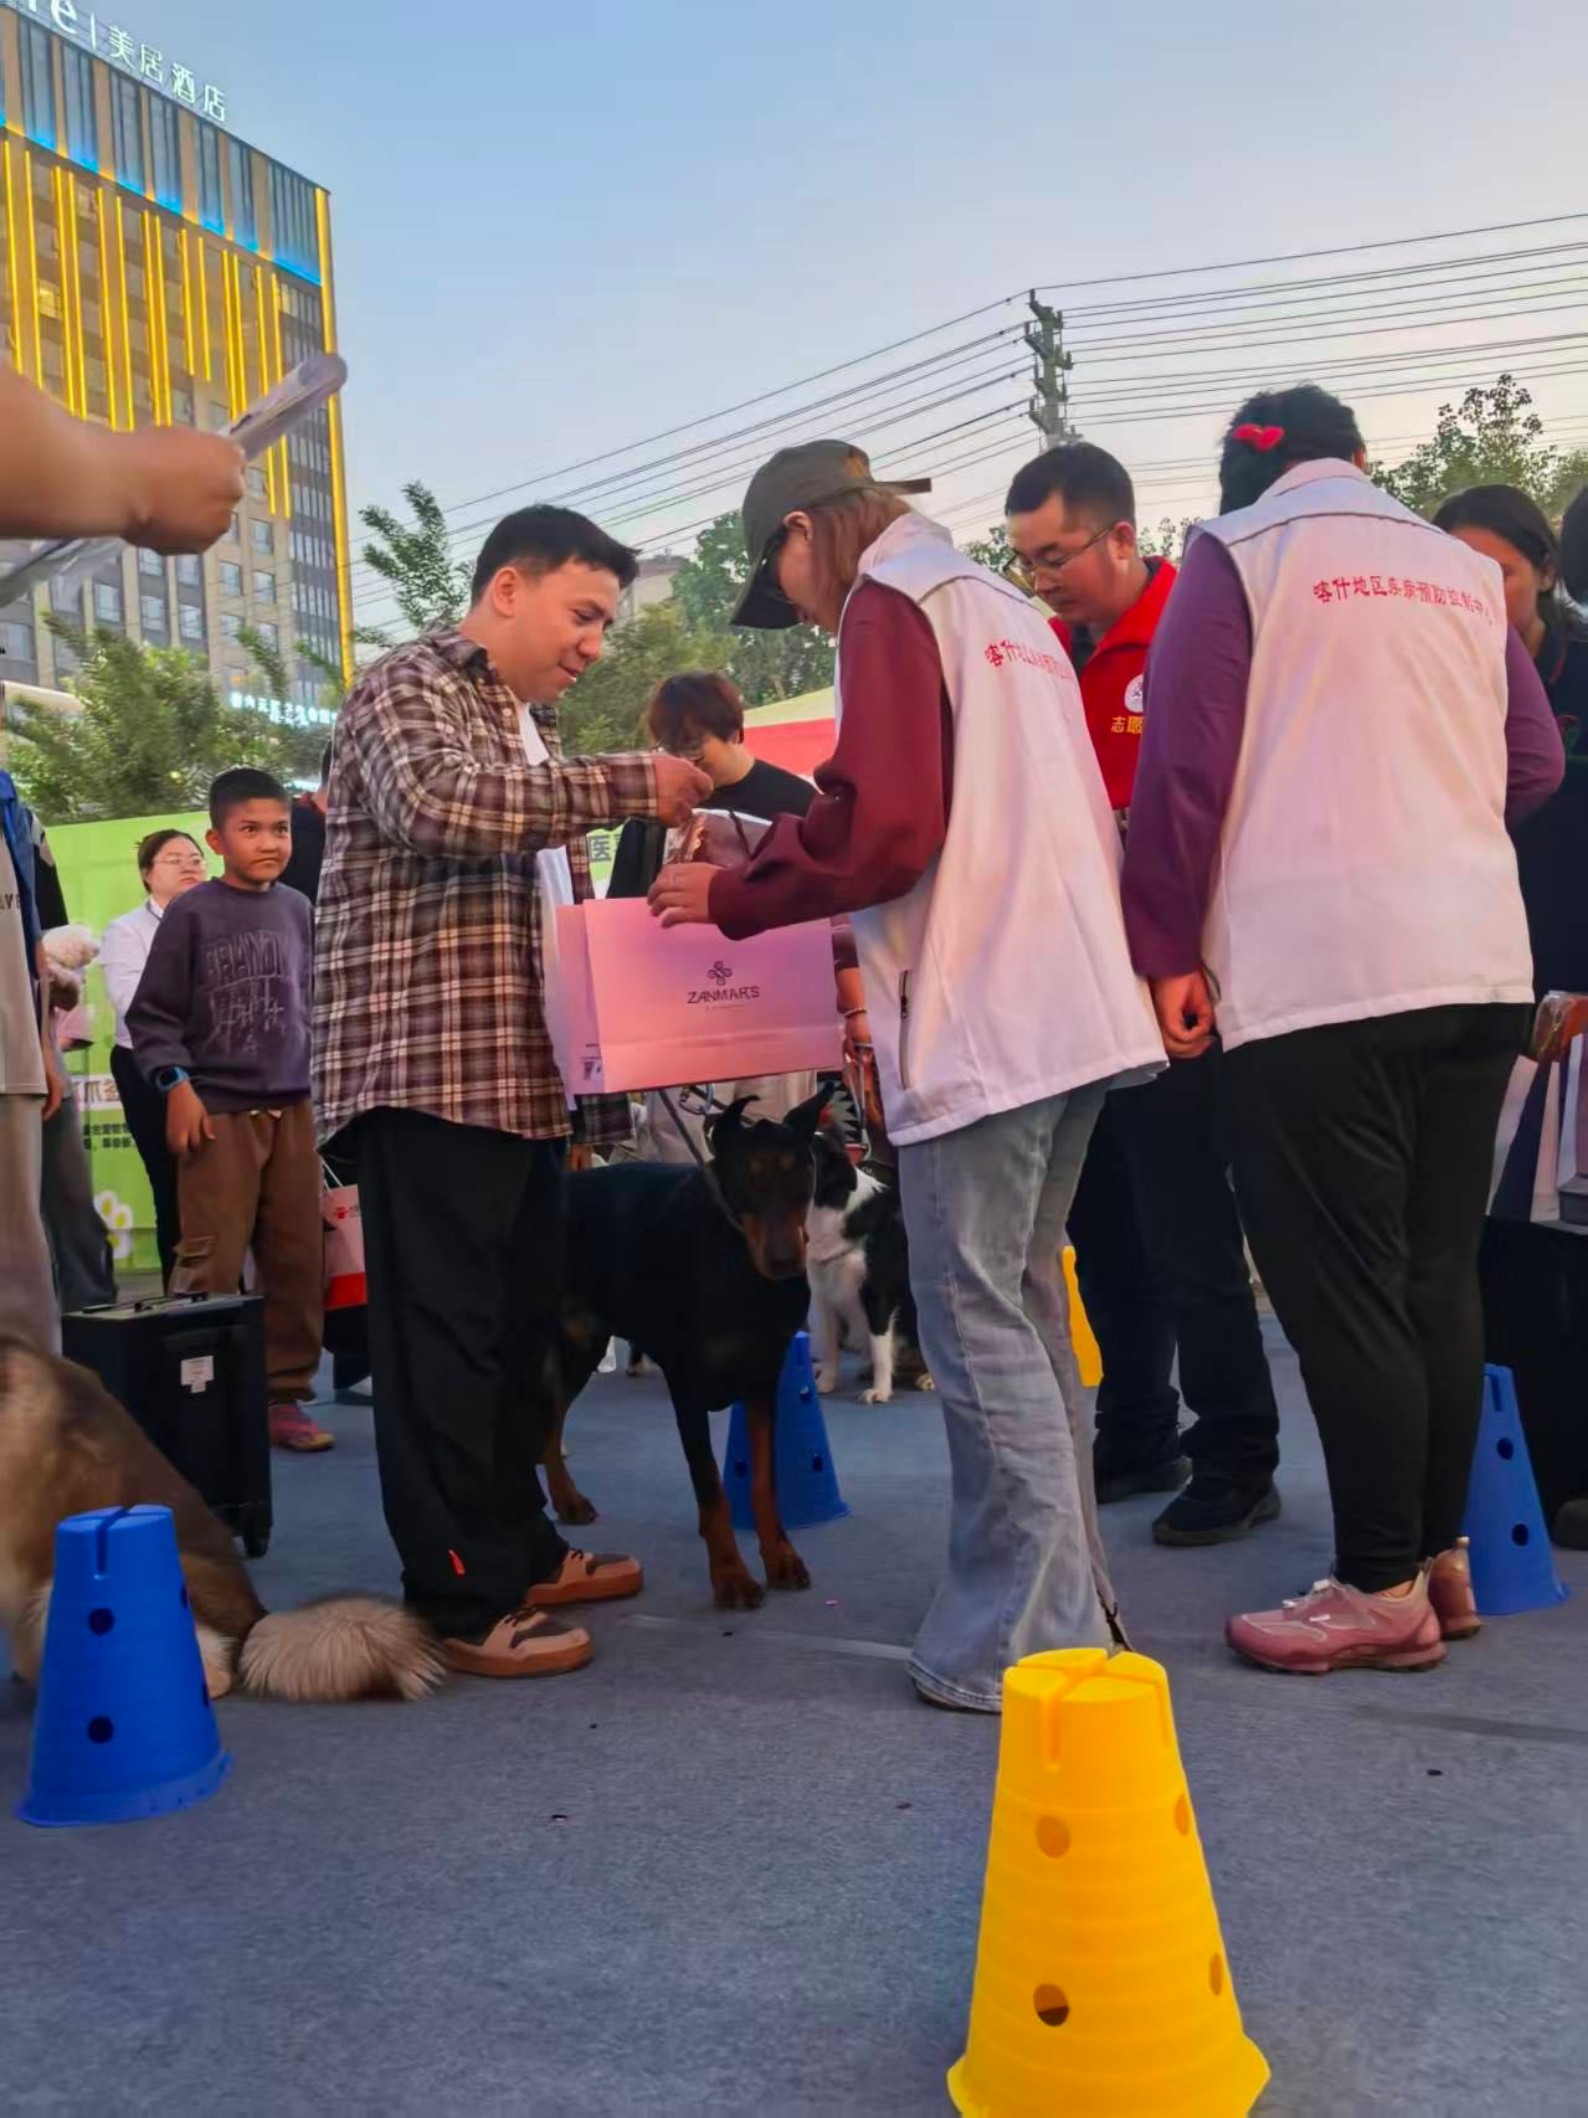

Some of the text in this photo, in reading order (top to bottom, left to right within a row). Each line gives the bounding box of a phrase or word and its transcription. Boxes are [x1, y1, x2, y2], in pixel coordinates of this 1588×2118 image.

[108, 26, 226, 122] 美居酒店
[1313, 575, 1493, 626] 喀什地区疾病预防控制中
[1110, 715, 1145, 734] 志愿
